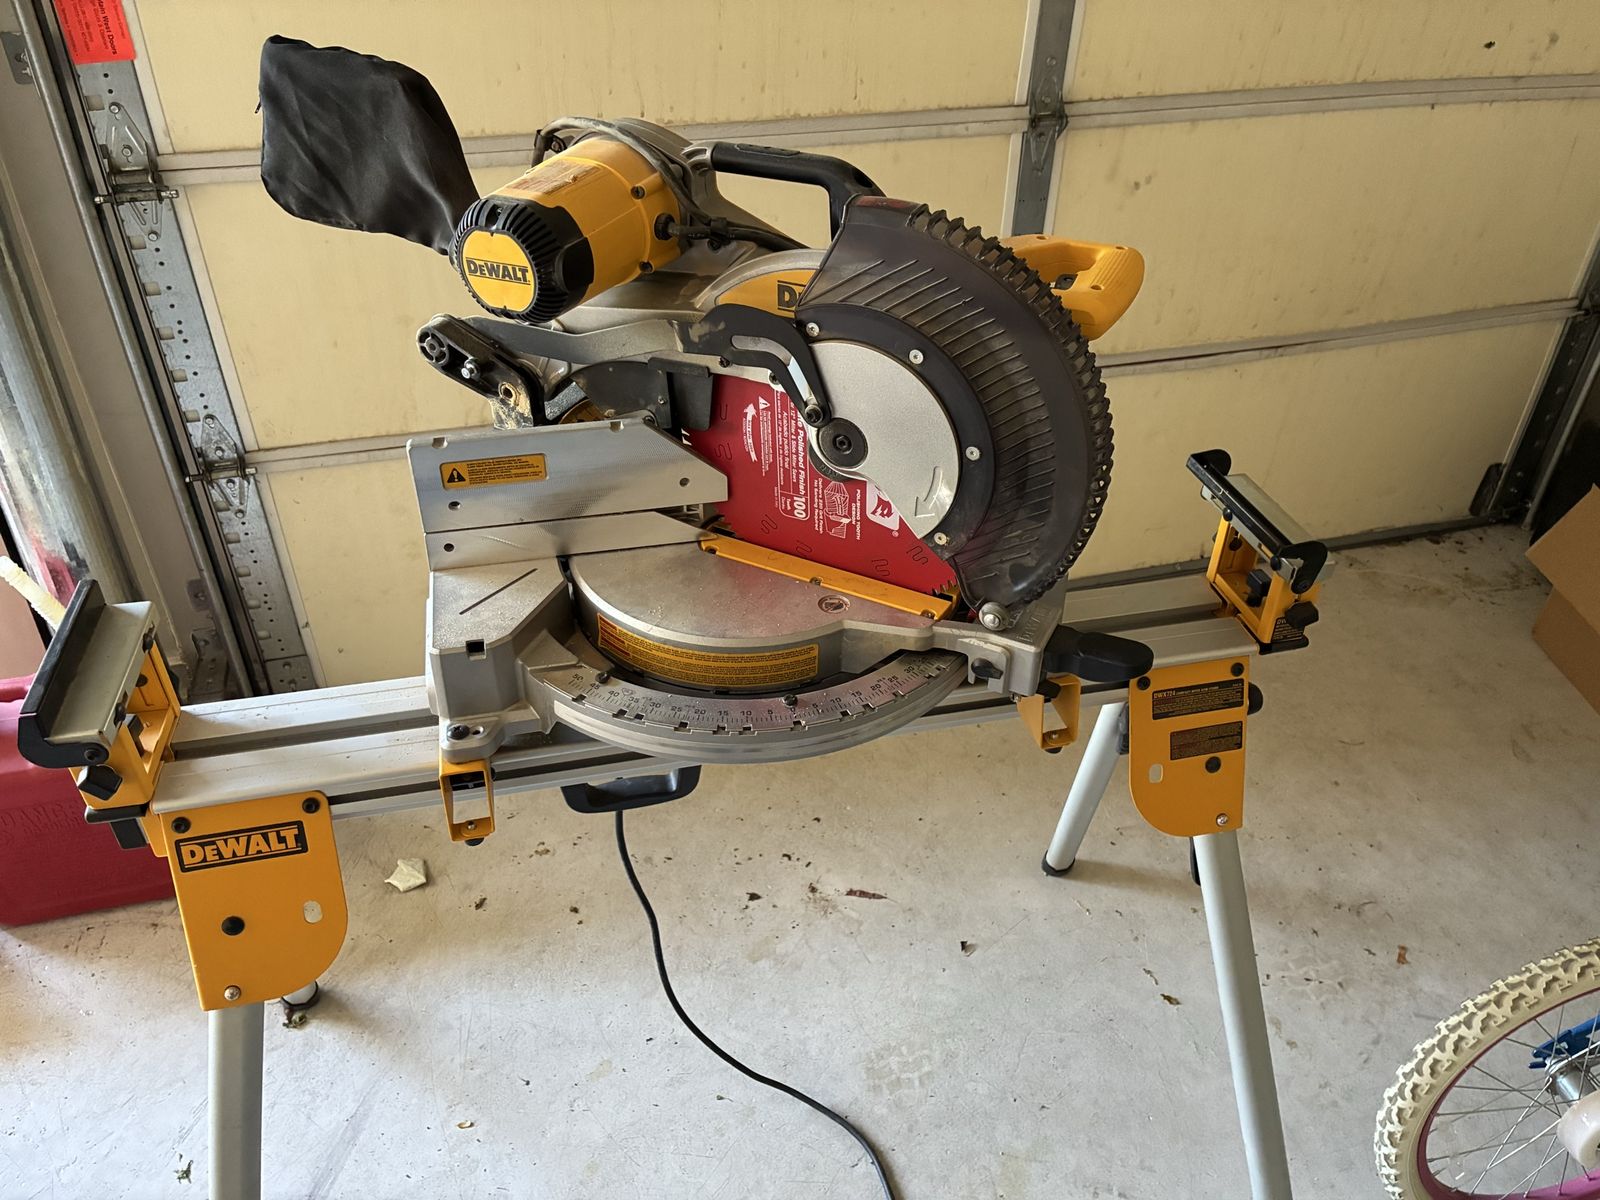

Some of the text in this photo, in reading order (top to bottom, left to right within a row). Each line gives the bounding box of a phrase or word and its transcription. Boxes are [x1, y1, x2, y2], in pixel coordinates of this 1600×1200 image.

[107, 34, 118, 55] Doors
[797, 429, 805, 469] Polished
[798, 469, 806, 495] Finish
[793, 496, 806, 518] 100
[572, 673, 584, 681] 50
[590, 682, 600, 690] 45
[629, 696, 640, 704] 35
[649, 701, 661, 709] 30
[670, 705, 682, 713] 25
[851, 690, 863, 698] 15
[870, 683, 882, 691] 20
[903, 665, 915, 673] 30
